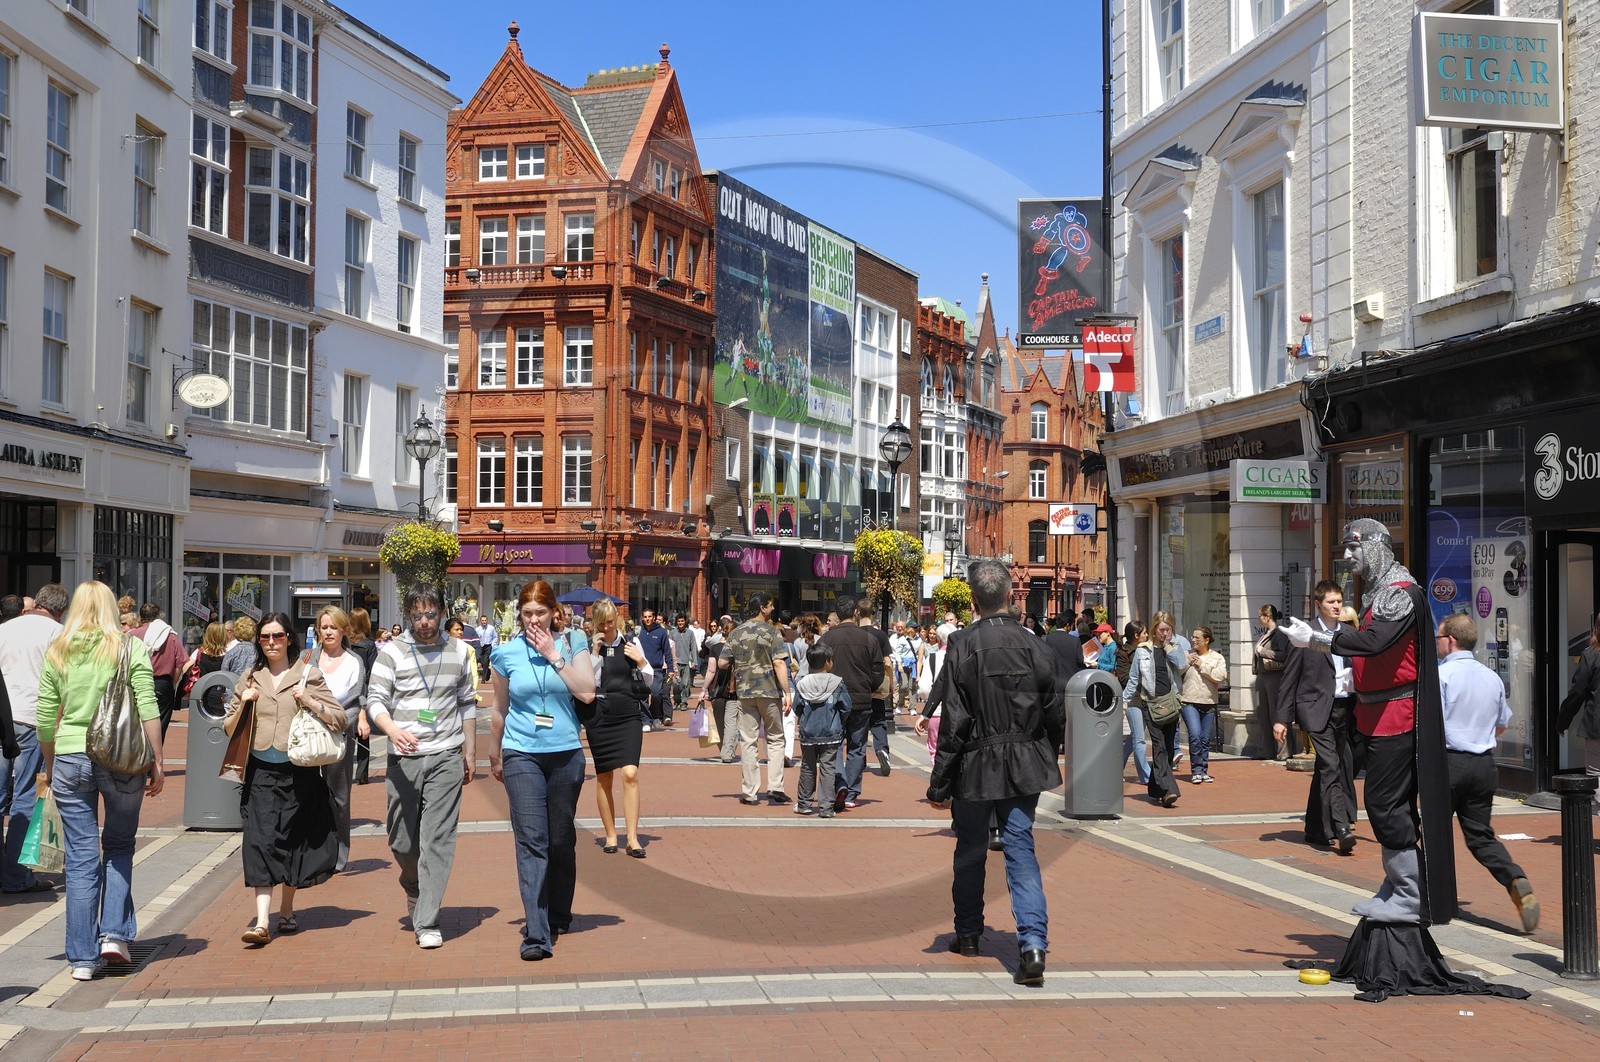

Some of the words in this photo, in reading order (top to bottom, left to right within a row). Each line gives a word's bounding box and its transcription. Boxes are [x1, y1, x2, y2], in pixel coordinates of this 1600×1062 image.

[1438, 32, 1473, 49] THE
[1477, 34, 1548, 53] DECENT
[1437, 55, 1549, 85] CIGAR
[1440, 86, 1549, 107] EMPORIUM
[720, 185, 742, 223] OUT
[745, 197, 768, 235] NOW
[770, 211, 784, 244] ON
[786, 219, 806, 253] DVD
[810, 231, 854, 276] REACHING
[810, 260, 826, 290] FOR
[828, 268, 854, 301] GLORY
[1028, 289, 1078, 318] CAPTAIN
[1032, 296, 1097, 333] AMERICAS
[1025, 335, 1070, 344] COOKHOUSE
[1072, 335, 1079, 344] &
[1086, 331, 1132, 343] Adecco
[39, 450, 83, 474] ASHLEY
[1194, 440, 1264, 467] Acupuncture
[1246, 466, 1318, 484] CIGARS
[1534, 432, 1563, 500] 3
[863, 508, 871, 532] nex
[1437, 536, 1464, 545] Come
[478, 544, 533, 564] Monsoon
[653, 547, 677, 565] Monsoon
[1474, 544, 1496, 565] €99
[1472, 569, 1480, 578] on
[1481, 567, 1495, 580] 3Pay
[1434, 585, 1454, 596] €99
